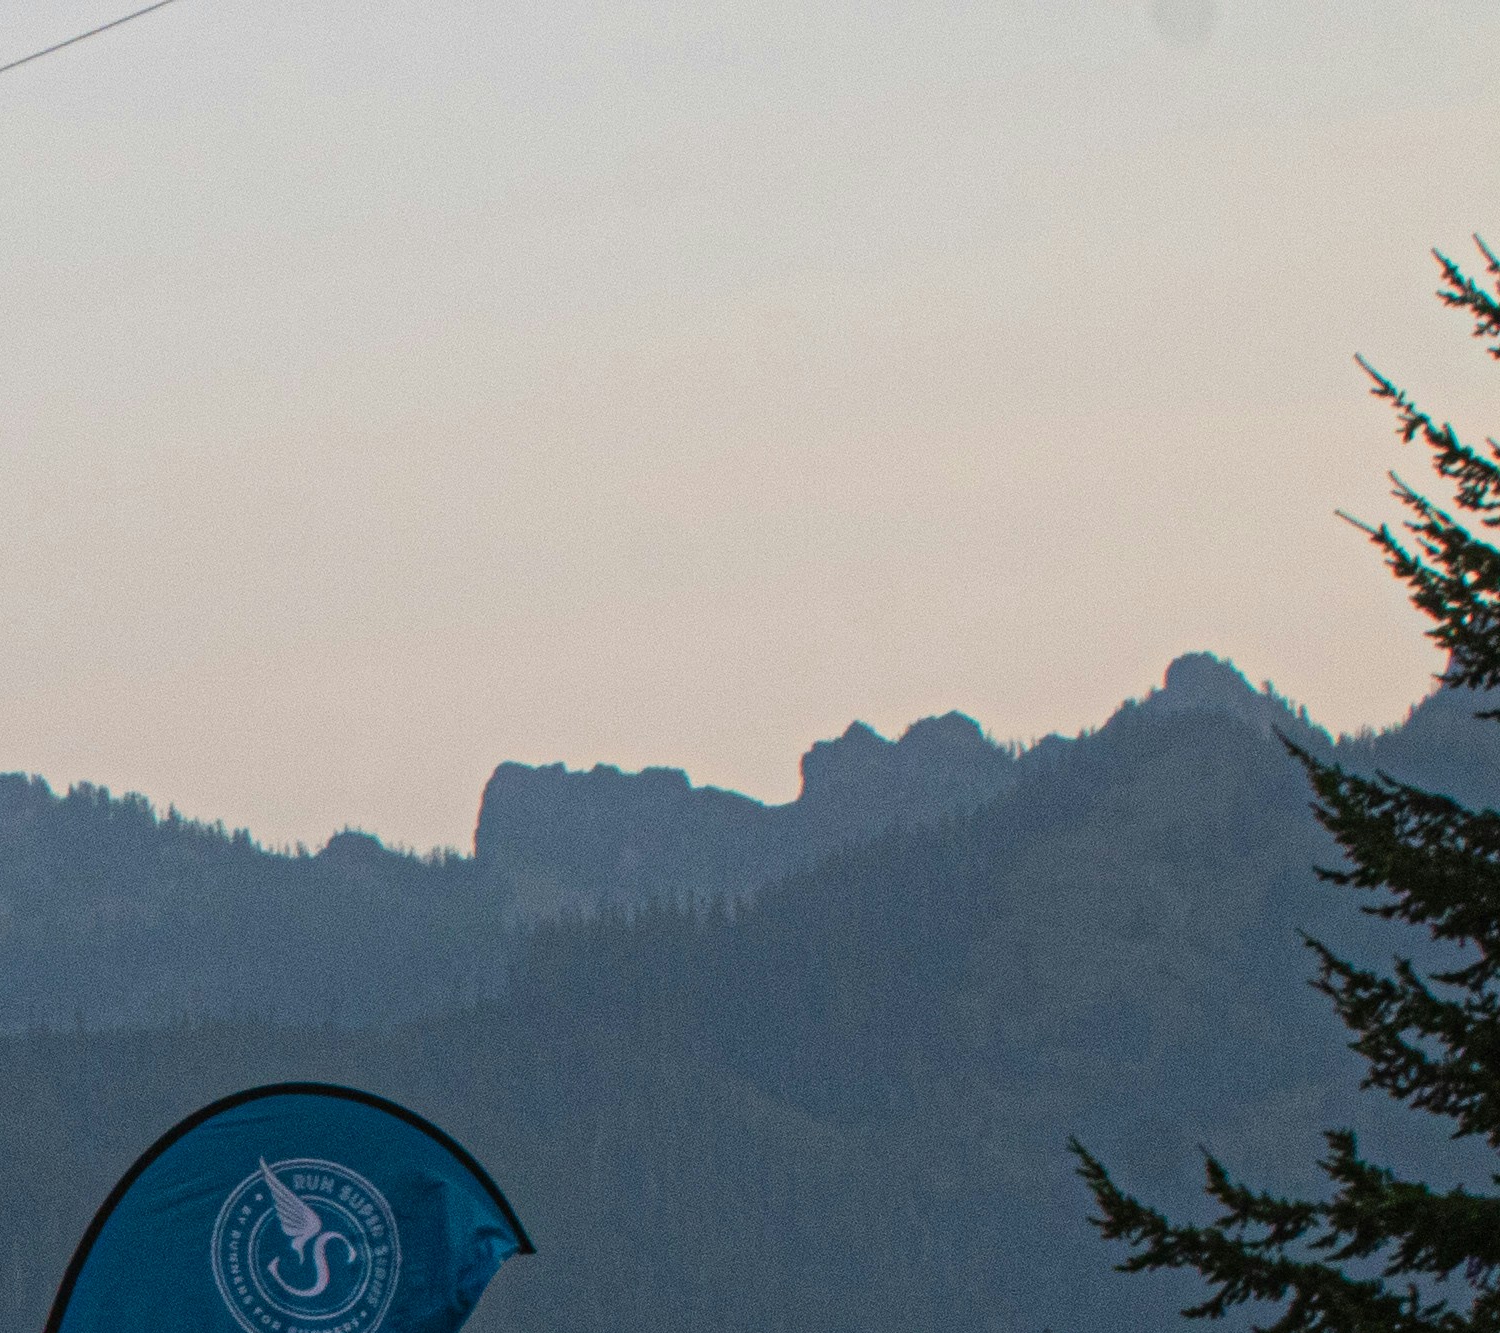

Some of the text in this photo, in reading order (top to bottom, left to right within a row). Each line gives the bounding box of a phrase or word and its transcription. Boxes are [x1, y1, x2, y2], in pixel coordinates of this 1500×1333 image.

[292, 1173, 336, 1195] RUN
[339, 1184, 387, 1239] SUPER
[253, 1305, 283, 1331] FOR
